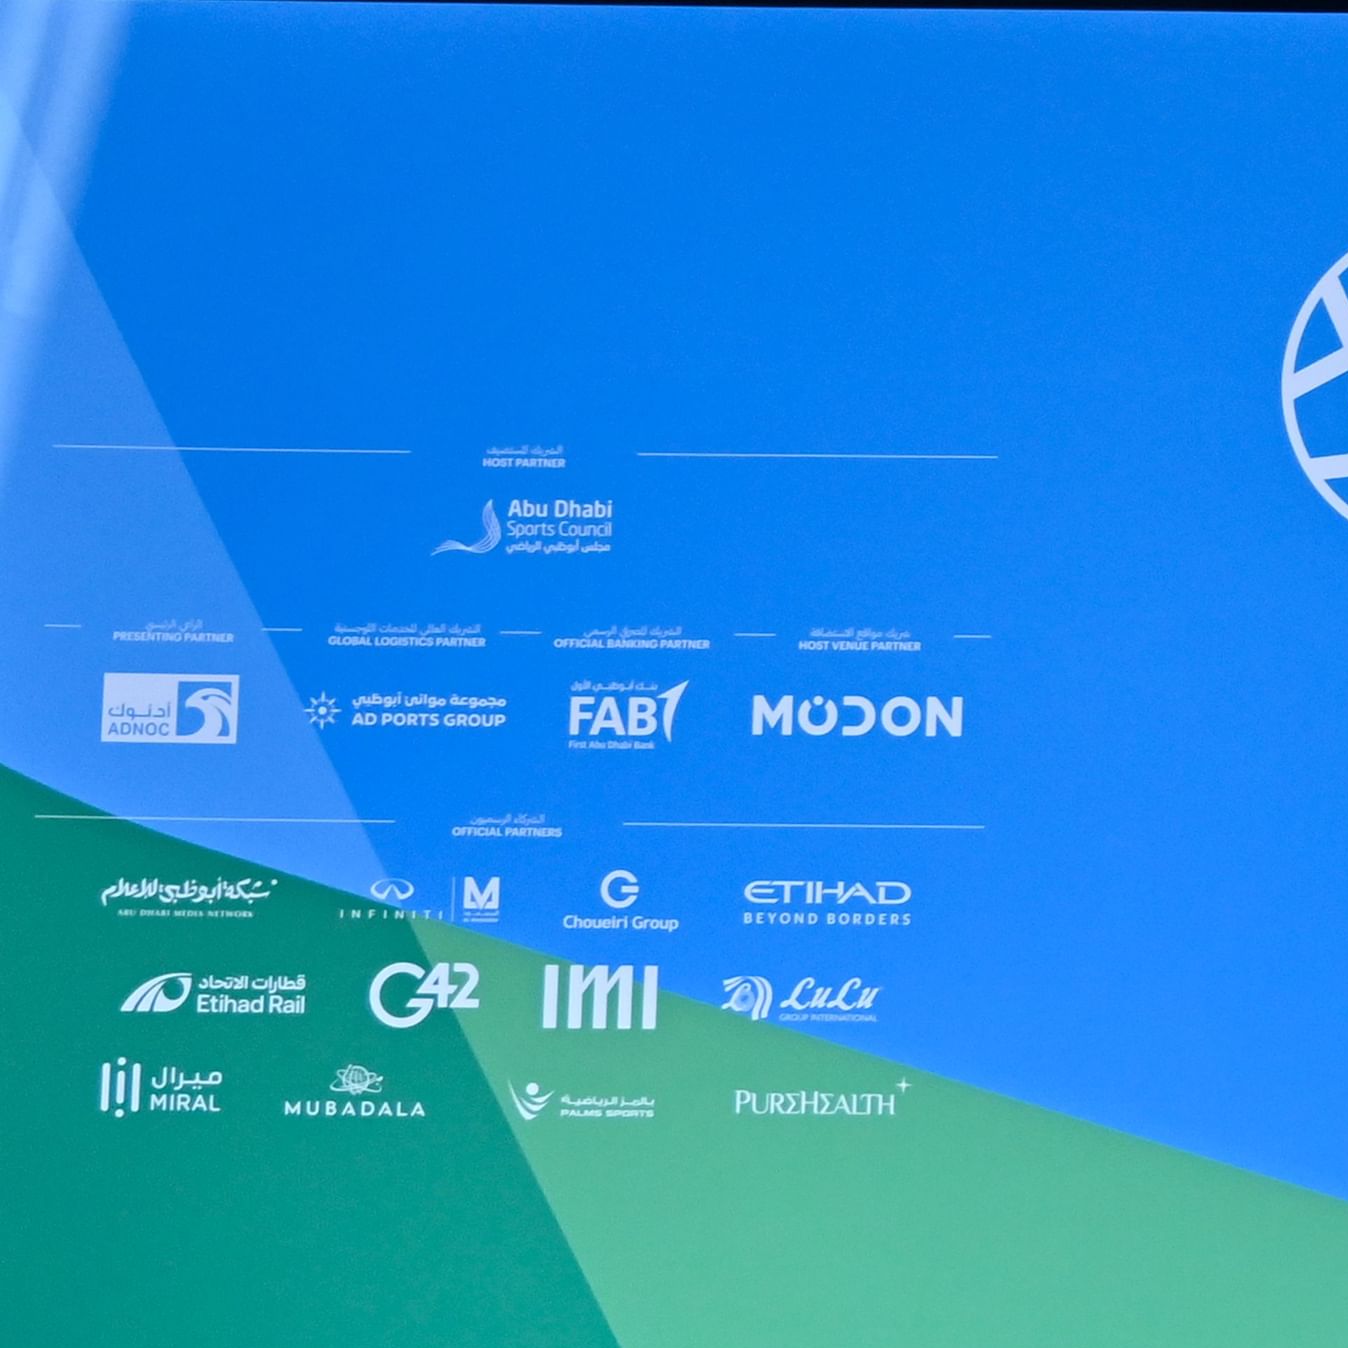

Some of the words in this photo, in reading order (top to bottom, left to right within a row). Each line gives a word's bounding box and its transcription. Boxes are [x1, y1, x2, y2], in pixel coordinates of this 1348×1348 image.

[482, 458, 513, 467] HOST
[515, 459, 566, 468] PARTNER
[508, 499, 548, 517] Abu
[554, 499, 613, 518] Dhabi
[507, 521, 556, 538] Sports
[559, 521, 612, 537] Council
[113, 632, 181, 642] PRESENTING
[184, 633, 234, 642] PARTNER
[328, 636, 372, 646] GLOBAL
[375, 636, 434, 646] LOGISTICS
[436, 637, 486, 647] PARTNER
[553, 639, 605, 648] OFFICIAL
[607, 639, 658, 649] BANKING
[660, 639, 710, 649] PARTNER
[798, 641, 829, 650] HOST
[832, 641, 868, 651] VENUE
[871, 642, 921, 651] PARTNER
[352, 691, 401, 709] أبوظبي
[450, 693, 507, 709] مجموعة
[352, 712, 377, 726] AD
[381, 713, 439, 726] PORTS
[443, 714, 506, 727] GROUP
[569, 696, 658, 736] FAB
[752, 694, 963, 737] MODON
[108, 722, 170, 736] ADNOC
[569, 740, 587, 749] First
[451, 826, 503, 837] OFFICIAL
[505, 827, 562, 837] PARTNERS
[743, 880, 912, 905] ETIHAD
[339, 909, 443, 920] INFINITI
[743, 912, 818, 925] BEYOND
[827, 913, 912, 926] BORDERS
[563, 914, 628, 929] Choueiri
[631, 916, 680, 933] Group
[198, 975, 249, 990] الاتحاد
[252, 974, 307, 994] قطارات
[369, 961, 480, 1029] G42
[542, 964, 659, 1030] IMI
[780, 977, 880, 1011] LuLu
[196, 993, 264, 1013] Etihad
[268, 995, 306, 1014] Rail
[152, 1066, 223, 1091] ميرال
[150, 1094, 221, 1112] MIRAL
[284, 1100, 426, 1117] MUBADALA
[560, 1109, 603, 1117] PALMS
[606, 1109, 654, 1118] SPORTS
